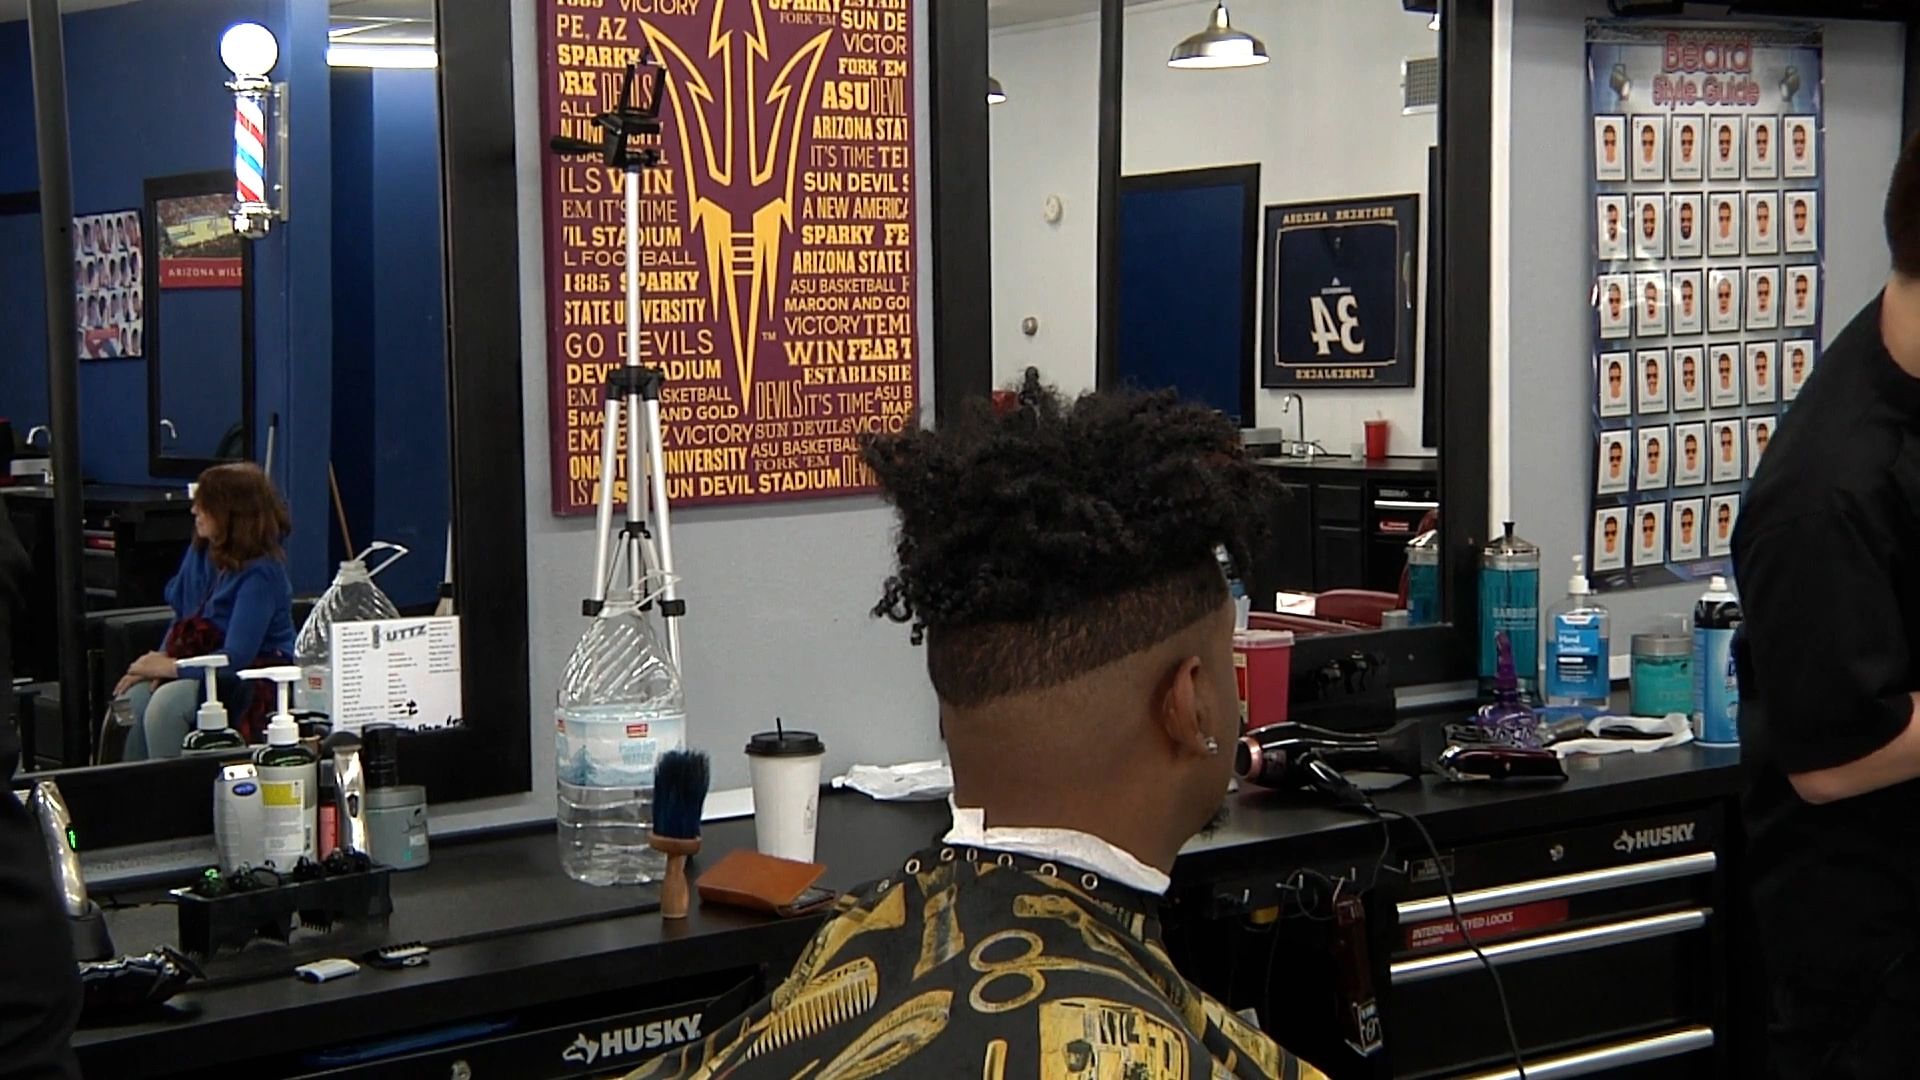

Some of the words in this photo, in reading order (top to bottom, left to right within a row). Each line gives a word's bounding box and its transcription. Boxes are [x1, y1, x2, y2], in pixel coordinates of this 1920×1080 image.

[620, 0, 698, 15] VICTORY
[780, 12, 813, 25] FORK
[557, 13, 591, 40] PE,
[597, 16, 627, 41] AZ
[841, 9, 879, 31] SUN
[884, 12, 906, 32] DE
[558, 43, 640, 68] SPARKY
[842, 33, 907, 55] VICTOR
[1665, 32, 1752, 73] Beard
[838, 57, 878, 75] FORK
[602, 72, 652, 113] DEILS
[822, 80, 870, 110] ASU
[870, 77, 908, 116] DEVIL
[1652, 74, 1697, 111] Style
[1702, 74, 1761, 106] Guide
[560, 100, 597, 117] ALL
[812, 115, 873, 139] ARIZONA
[811, 145, 837, 167] IT'S
[841, 145, 875, 168] TIME
[560, 167, 602, 194] ILS
[607, 168, 674, 194] WIN
[804, 171, 842, 192] SUN
[848, 172, 898, 192] DEVIL
[562, 200, 592, 219] EM
[639, 201, 677, 223] TIME
[802, 196, 814, 219] A
[817, 197, 849, 218] NEW
[592, 226, 681, 247] STAIUM
[802, 224, 874, 245] SPARKY
[884, 223, 910, 246] FE
[581, 250, 697, 266] FOOBALL
[793, 250, 856, 275] ARIZONA
[858, 251, 903, 274] STATE
[168, 267, 215, 277] ARIZONA
[563, 272, 611, 292] 1885
[790, 279, 816, 295] ASU
[820, 278, 896, 293] BASKETBALL
[564, 300, 610, 326] STATE
[614, 298, 706, 326] UVERSITY
[784, 297, 848, 313] MAROON
[852, 297, 883, 311] AND
[784, 315, 862, 337] VICTORY
[564, 331, 605, 358] GO
[617, 328, 714, 357] DEVILS
[783, 340, 844, 366] WIN
[846, 338, 899, 362] FEAR
[566, 363, 620, 384] DEV
[645, 359, 722, 381] ADIUM
[803, 364, 912, 386] ESTABLISHE
[567, 387, 597, 407] EM
[659, 386, 732, 403] SKETBALL
[755, 379, 802, 421] DEVILS
[804, 393, 833, 416] IT'S
[837, 391, 876, 415] TIME
[874, 385, 900, 401] ASU
[658, 407, 692, 422] AND
[696, 404, 740, 420] GOLD
[672, 423, 755, 447] VICTORY
[755, 421, 788, 439] SUN
[792, 418, 852, 437] DEVILS
[851, 415, 904, 435] VICTO
[751, 443, 778, 458] ASU
[782, 437, 860, 455] BASKETBAL
[667, 478, 694, 498] UN
[700, 474, 755, 496] DEVIL
[758, 467, 841, 494] STADIUM
[842, 453, 880, 487] DEVI
[755, 457, 798, 471] FORK
[1635, 823, 1695, 849] HUSKY
[601, 1013, 702, 1057] HUSKY
